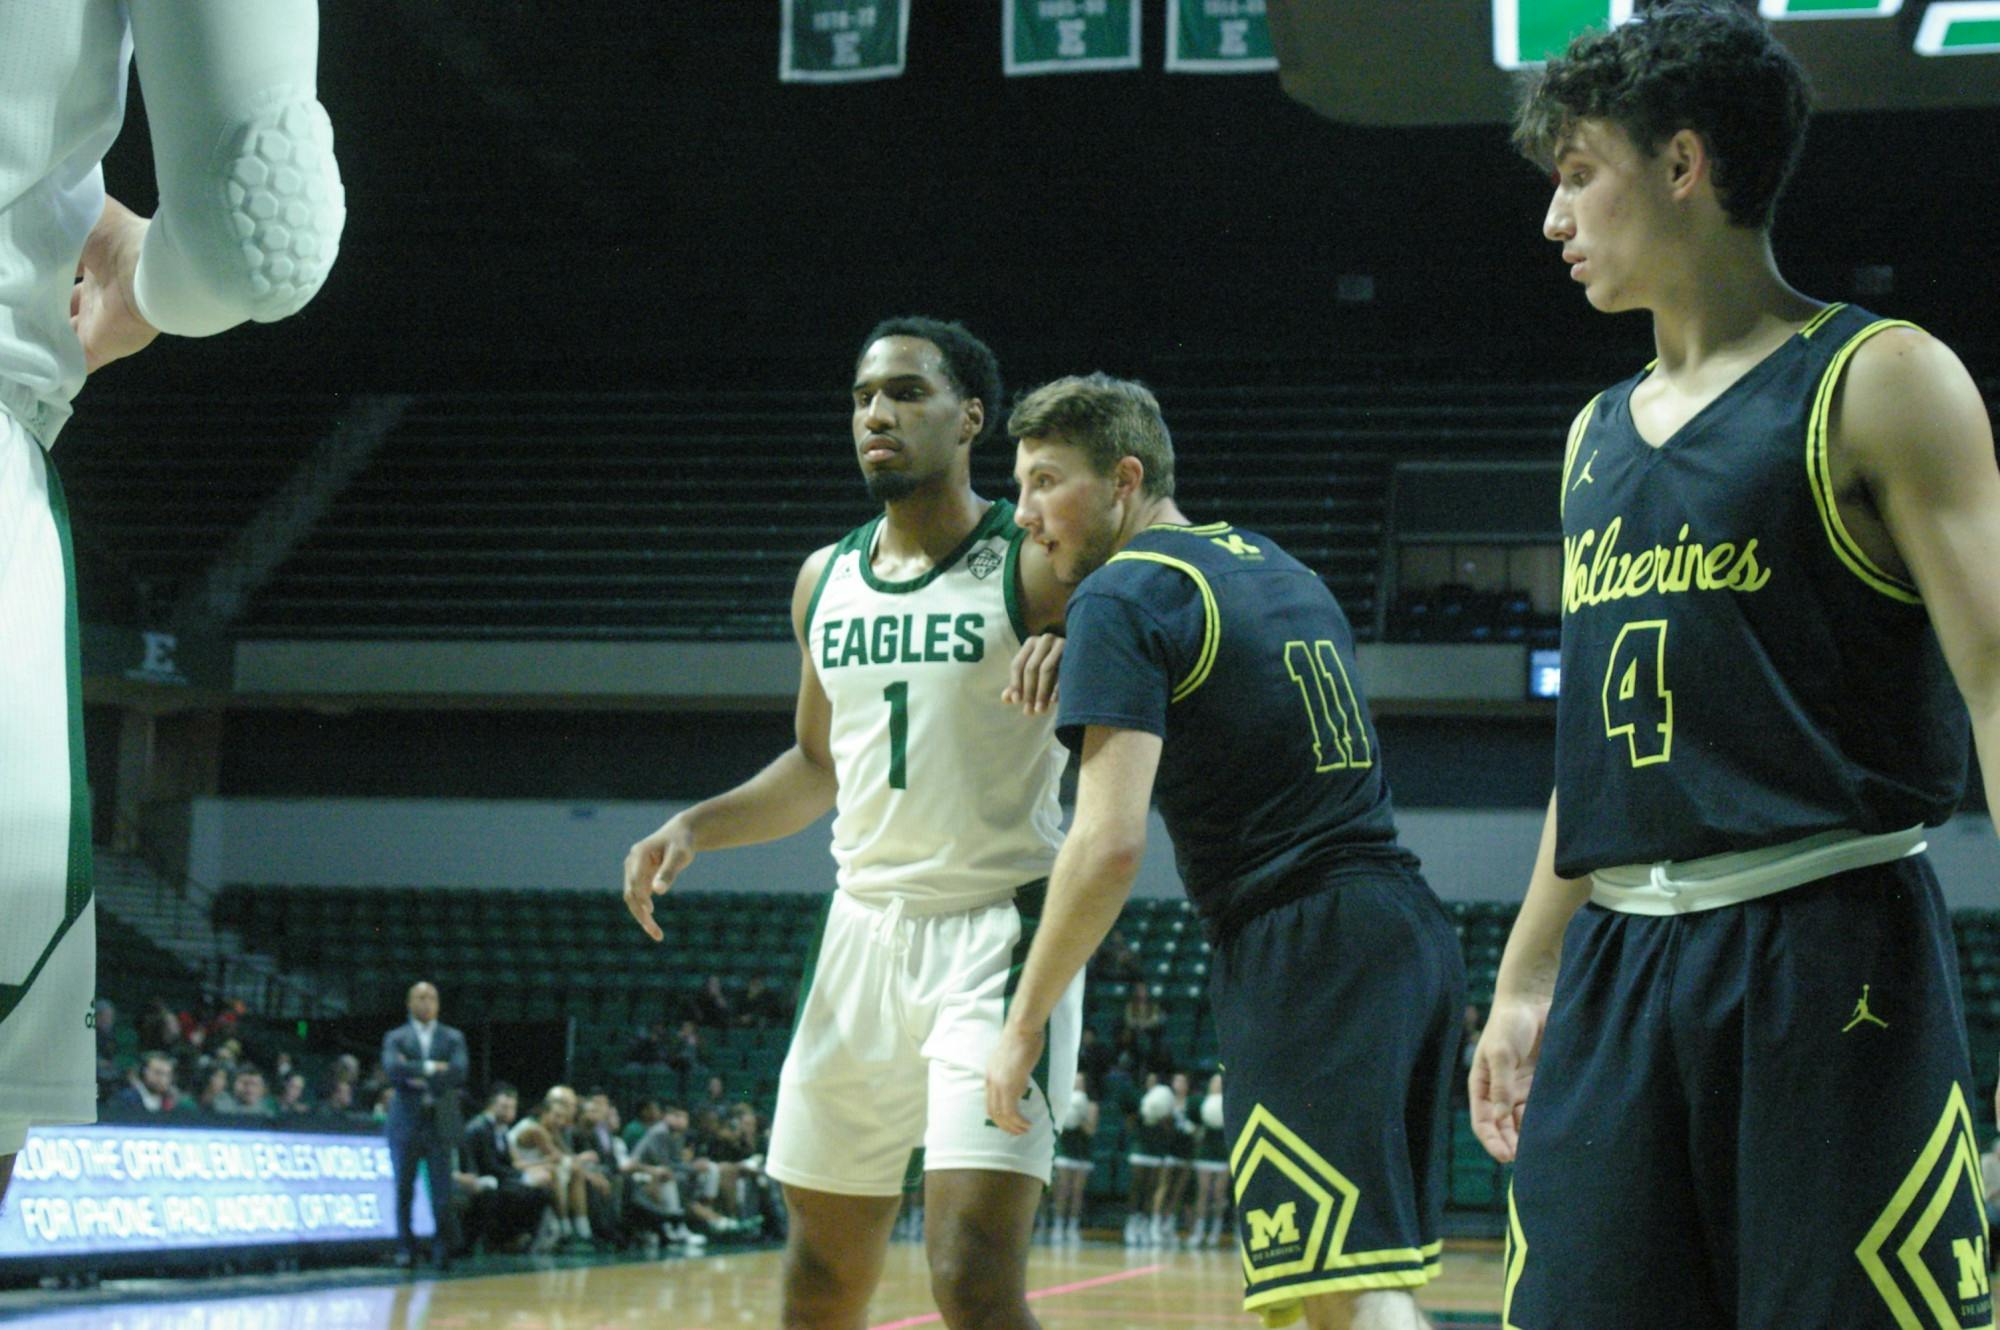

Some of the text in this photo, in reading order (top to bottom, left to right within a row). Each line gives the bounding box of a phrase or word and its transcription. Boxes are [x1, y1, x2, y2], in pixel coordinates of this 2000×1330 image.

[1562, 516, 1771, 614] Wolverines
[822, 613, 985, 669] EAGLES
[1284, 640, 1373, 773] 11
[1602, 619, 1673, 768] 4
[884, 681, 909, 790] 1
[75, 1138, 126, 1180] THE
[20, 1197, 77, 1241] FOR
[1246, 1201, 1300, 1252] M
